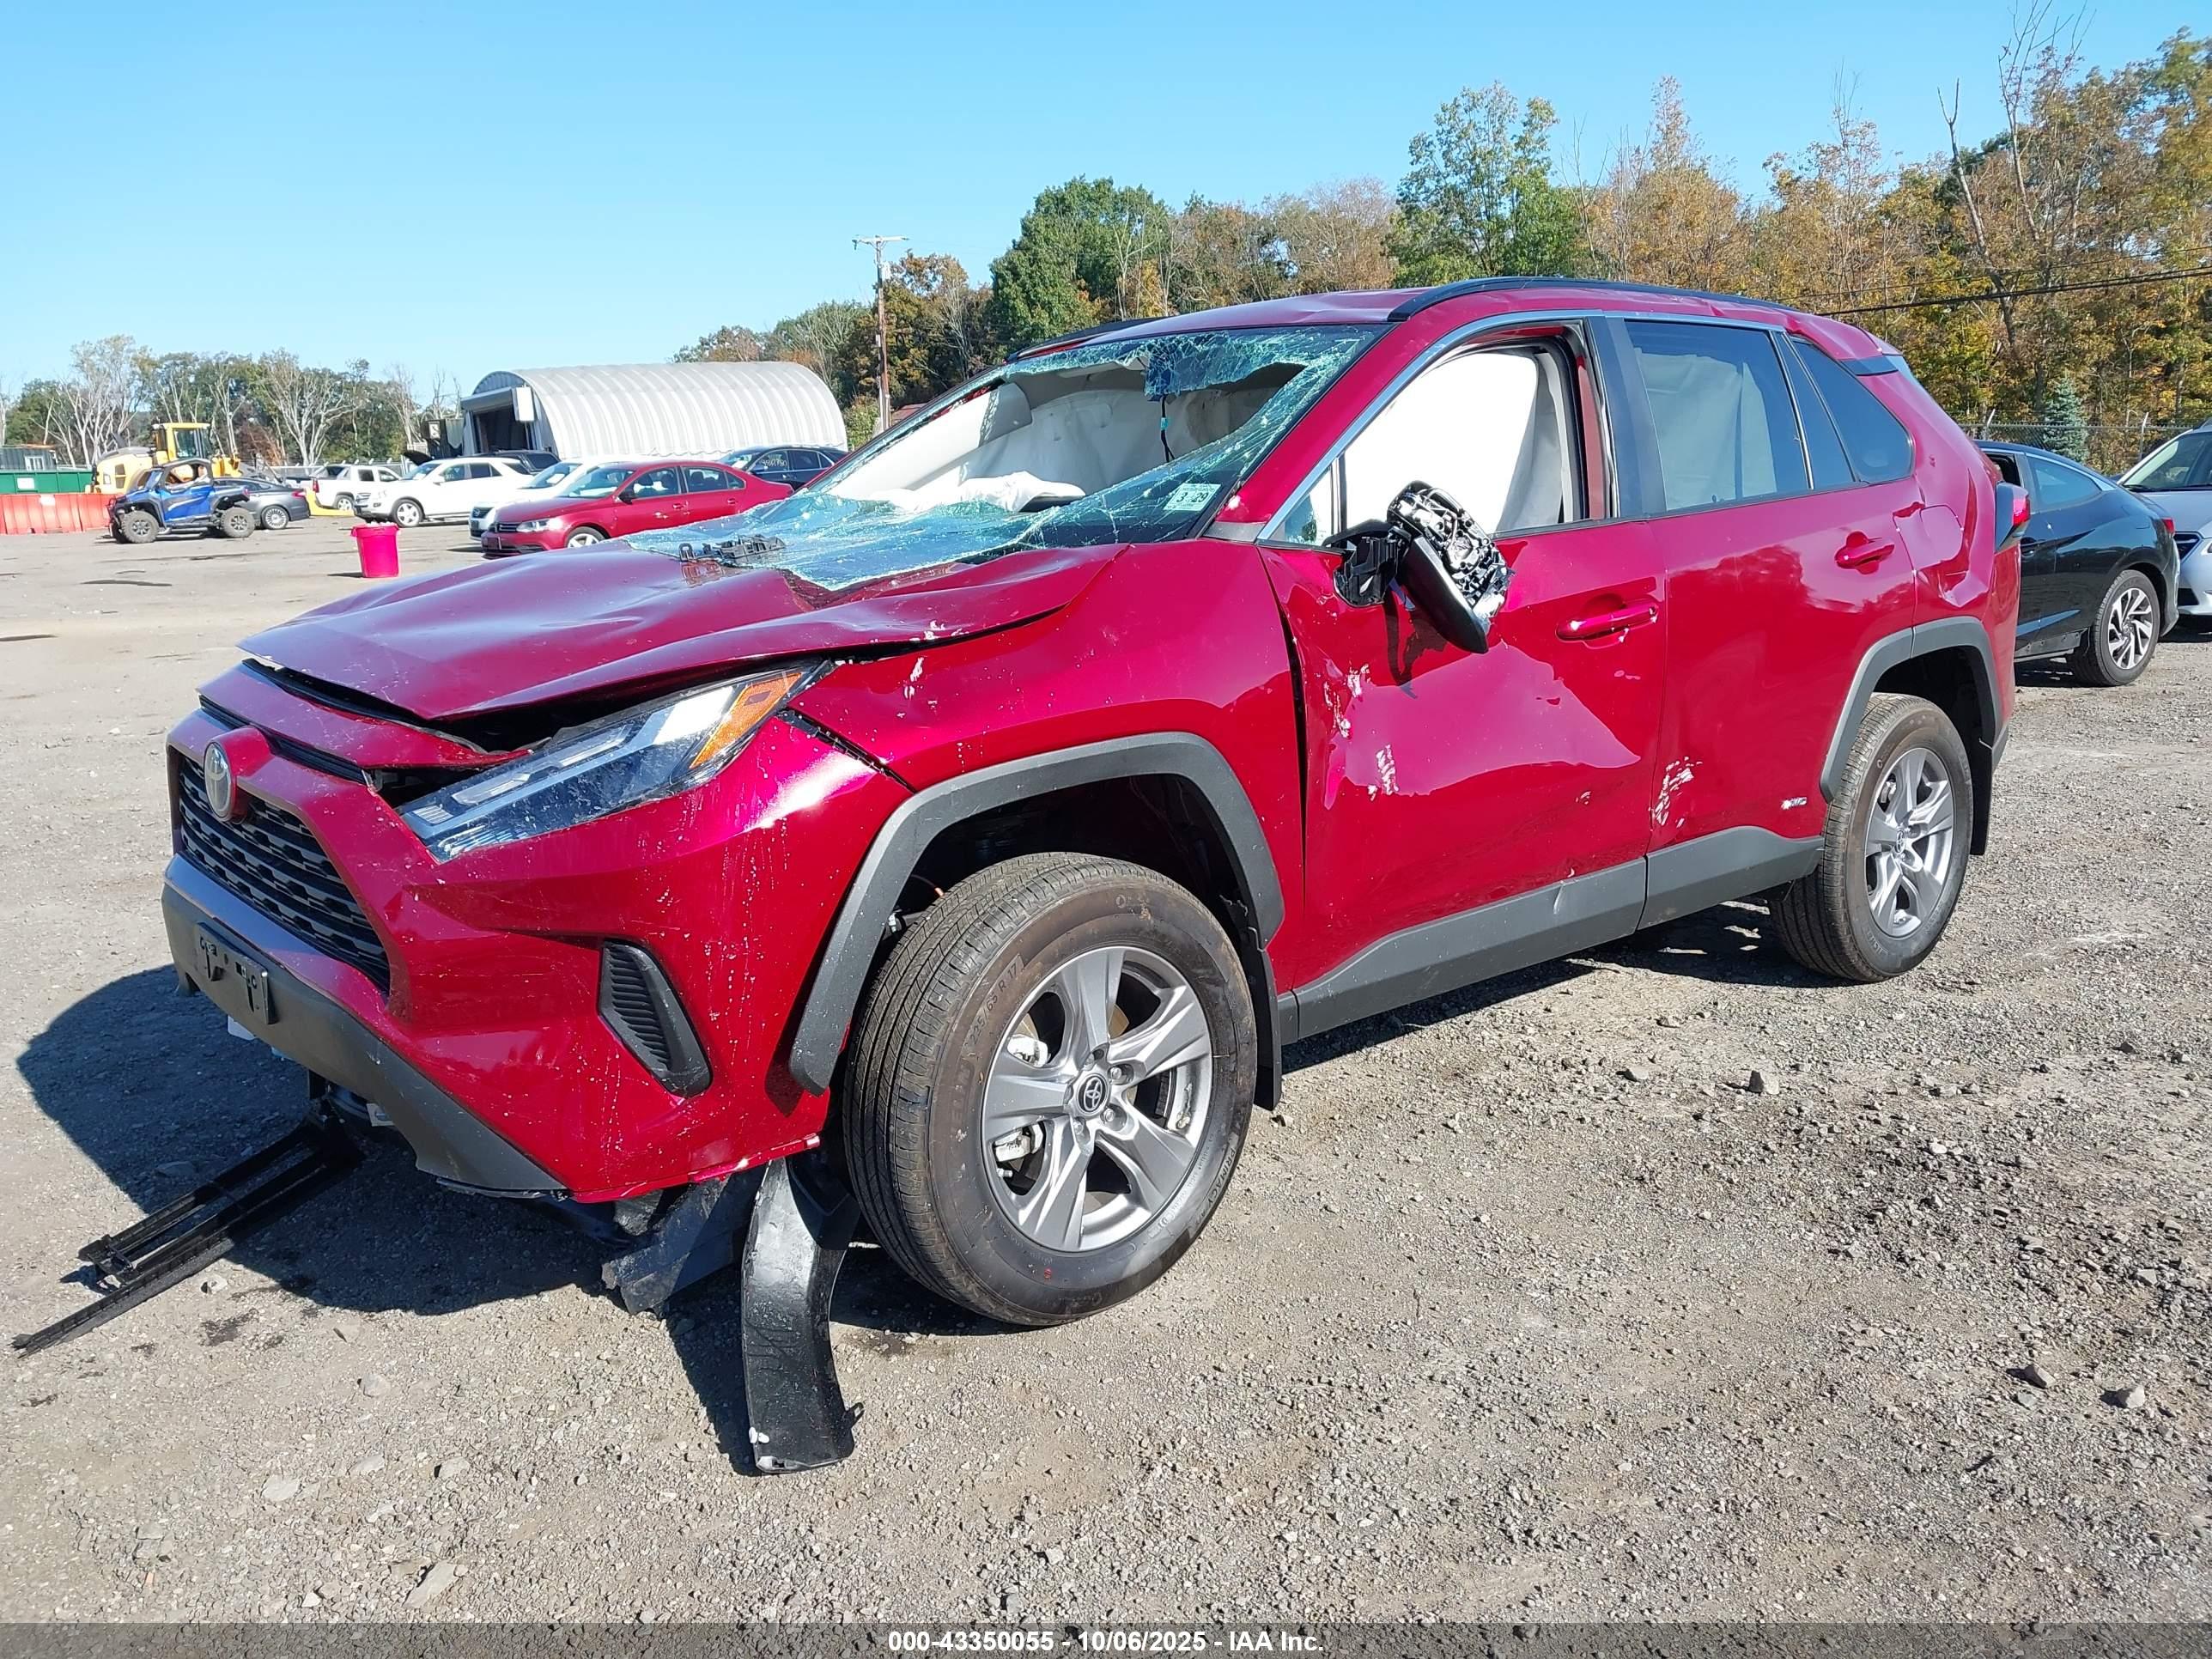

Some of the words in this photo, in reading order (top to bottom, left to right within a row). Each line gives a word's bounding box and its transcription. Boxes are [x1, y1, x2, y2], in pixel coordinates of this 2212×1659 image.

[1176, 491, 1188, 502] 3
[1191, 491, 1209, 503] 29
[1006, 963, 1018, 980] 17
[1206, 1146, 1237, 1208] PRIMACY
